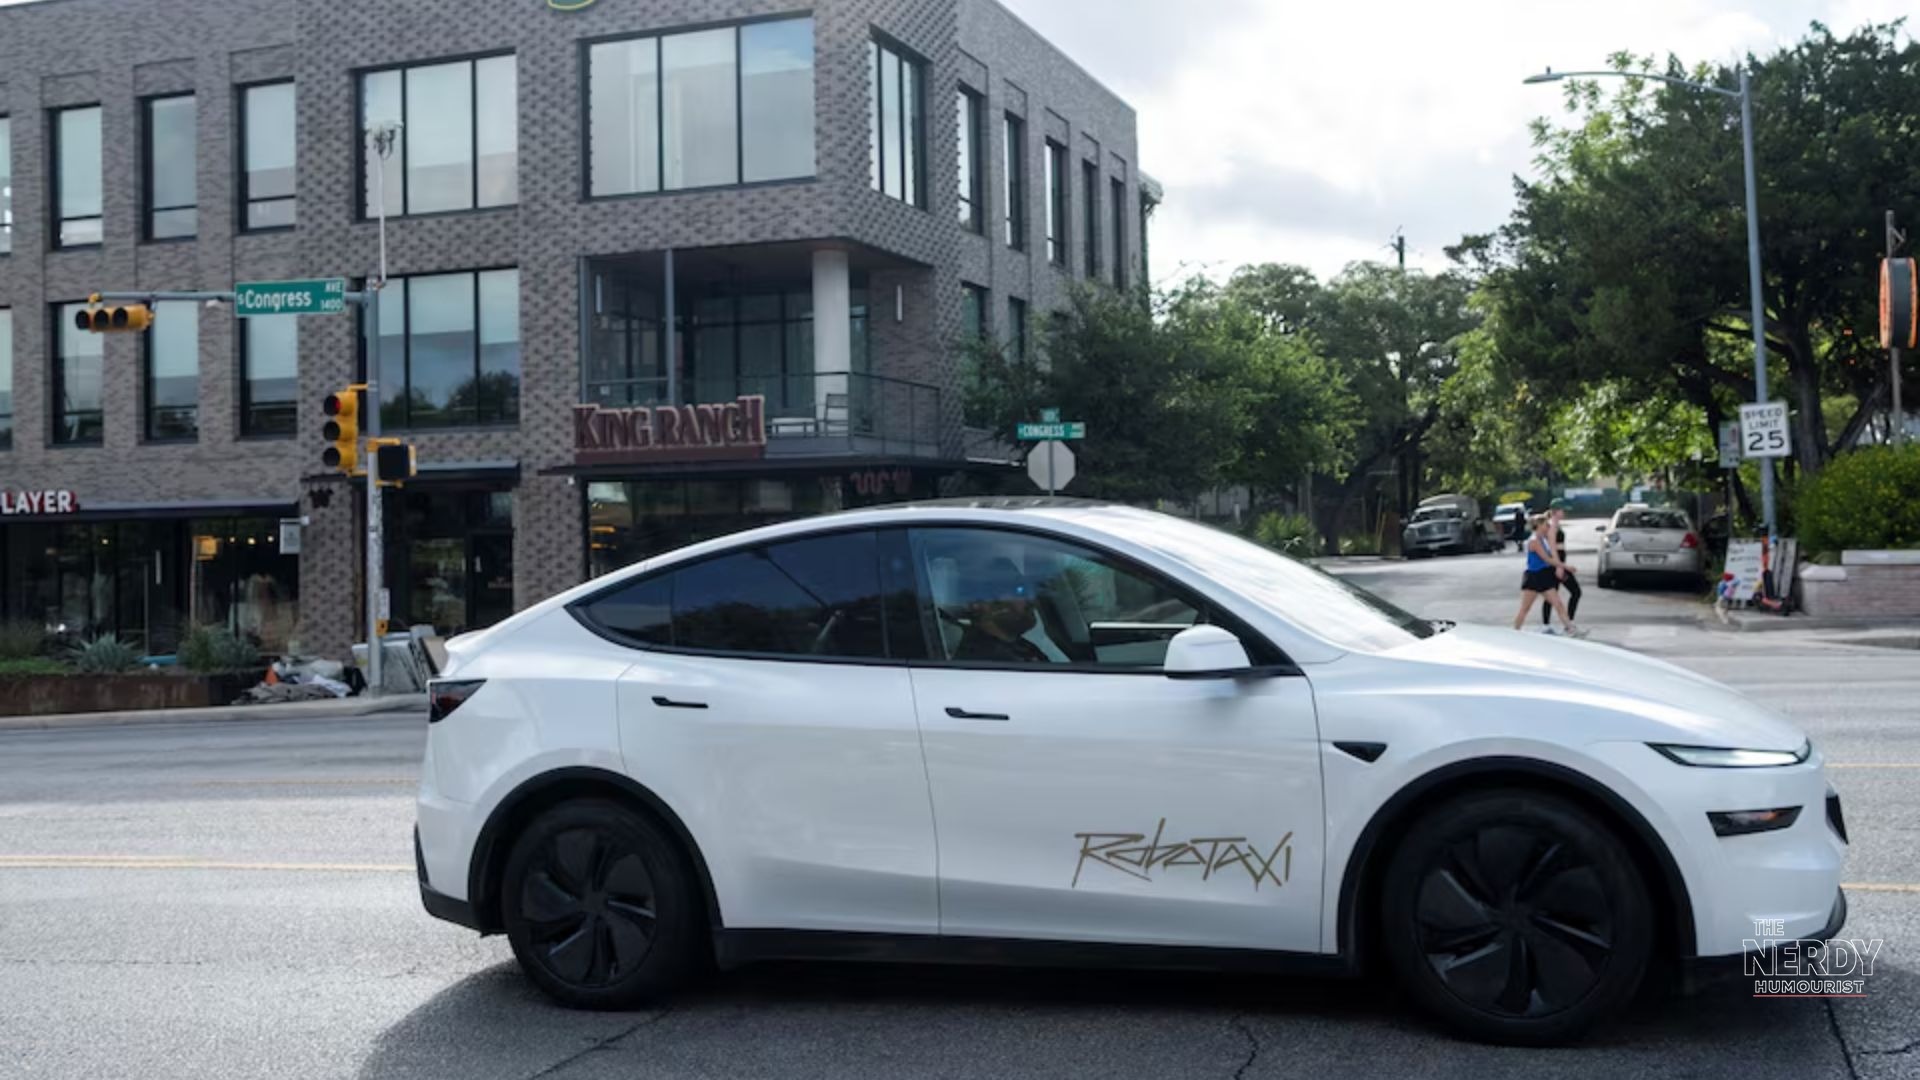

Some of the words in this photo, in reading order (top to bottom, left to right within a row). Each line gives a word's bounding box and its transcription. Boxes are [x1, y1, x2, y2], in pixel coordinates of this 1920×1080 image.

[325, 281, 342, 293] AVE
[245, 289, 312, 312] Congress
[573, 403, 651, 451] KING
[654, 394, 766, 449] RANCH
[1744, 407, 1783, 420] SPEED
[1749, 419, 1779, 431] LIMIT
[1748, 429, 1785, 451] 25
[1, 489, 78, 514] LAYER
